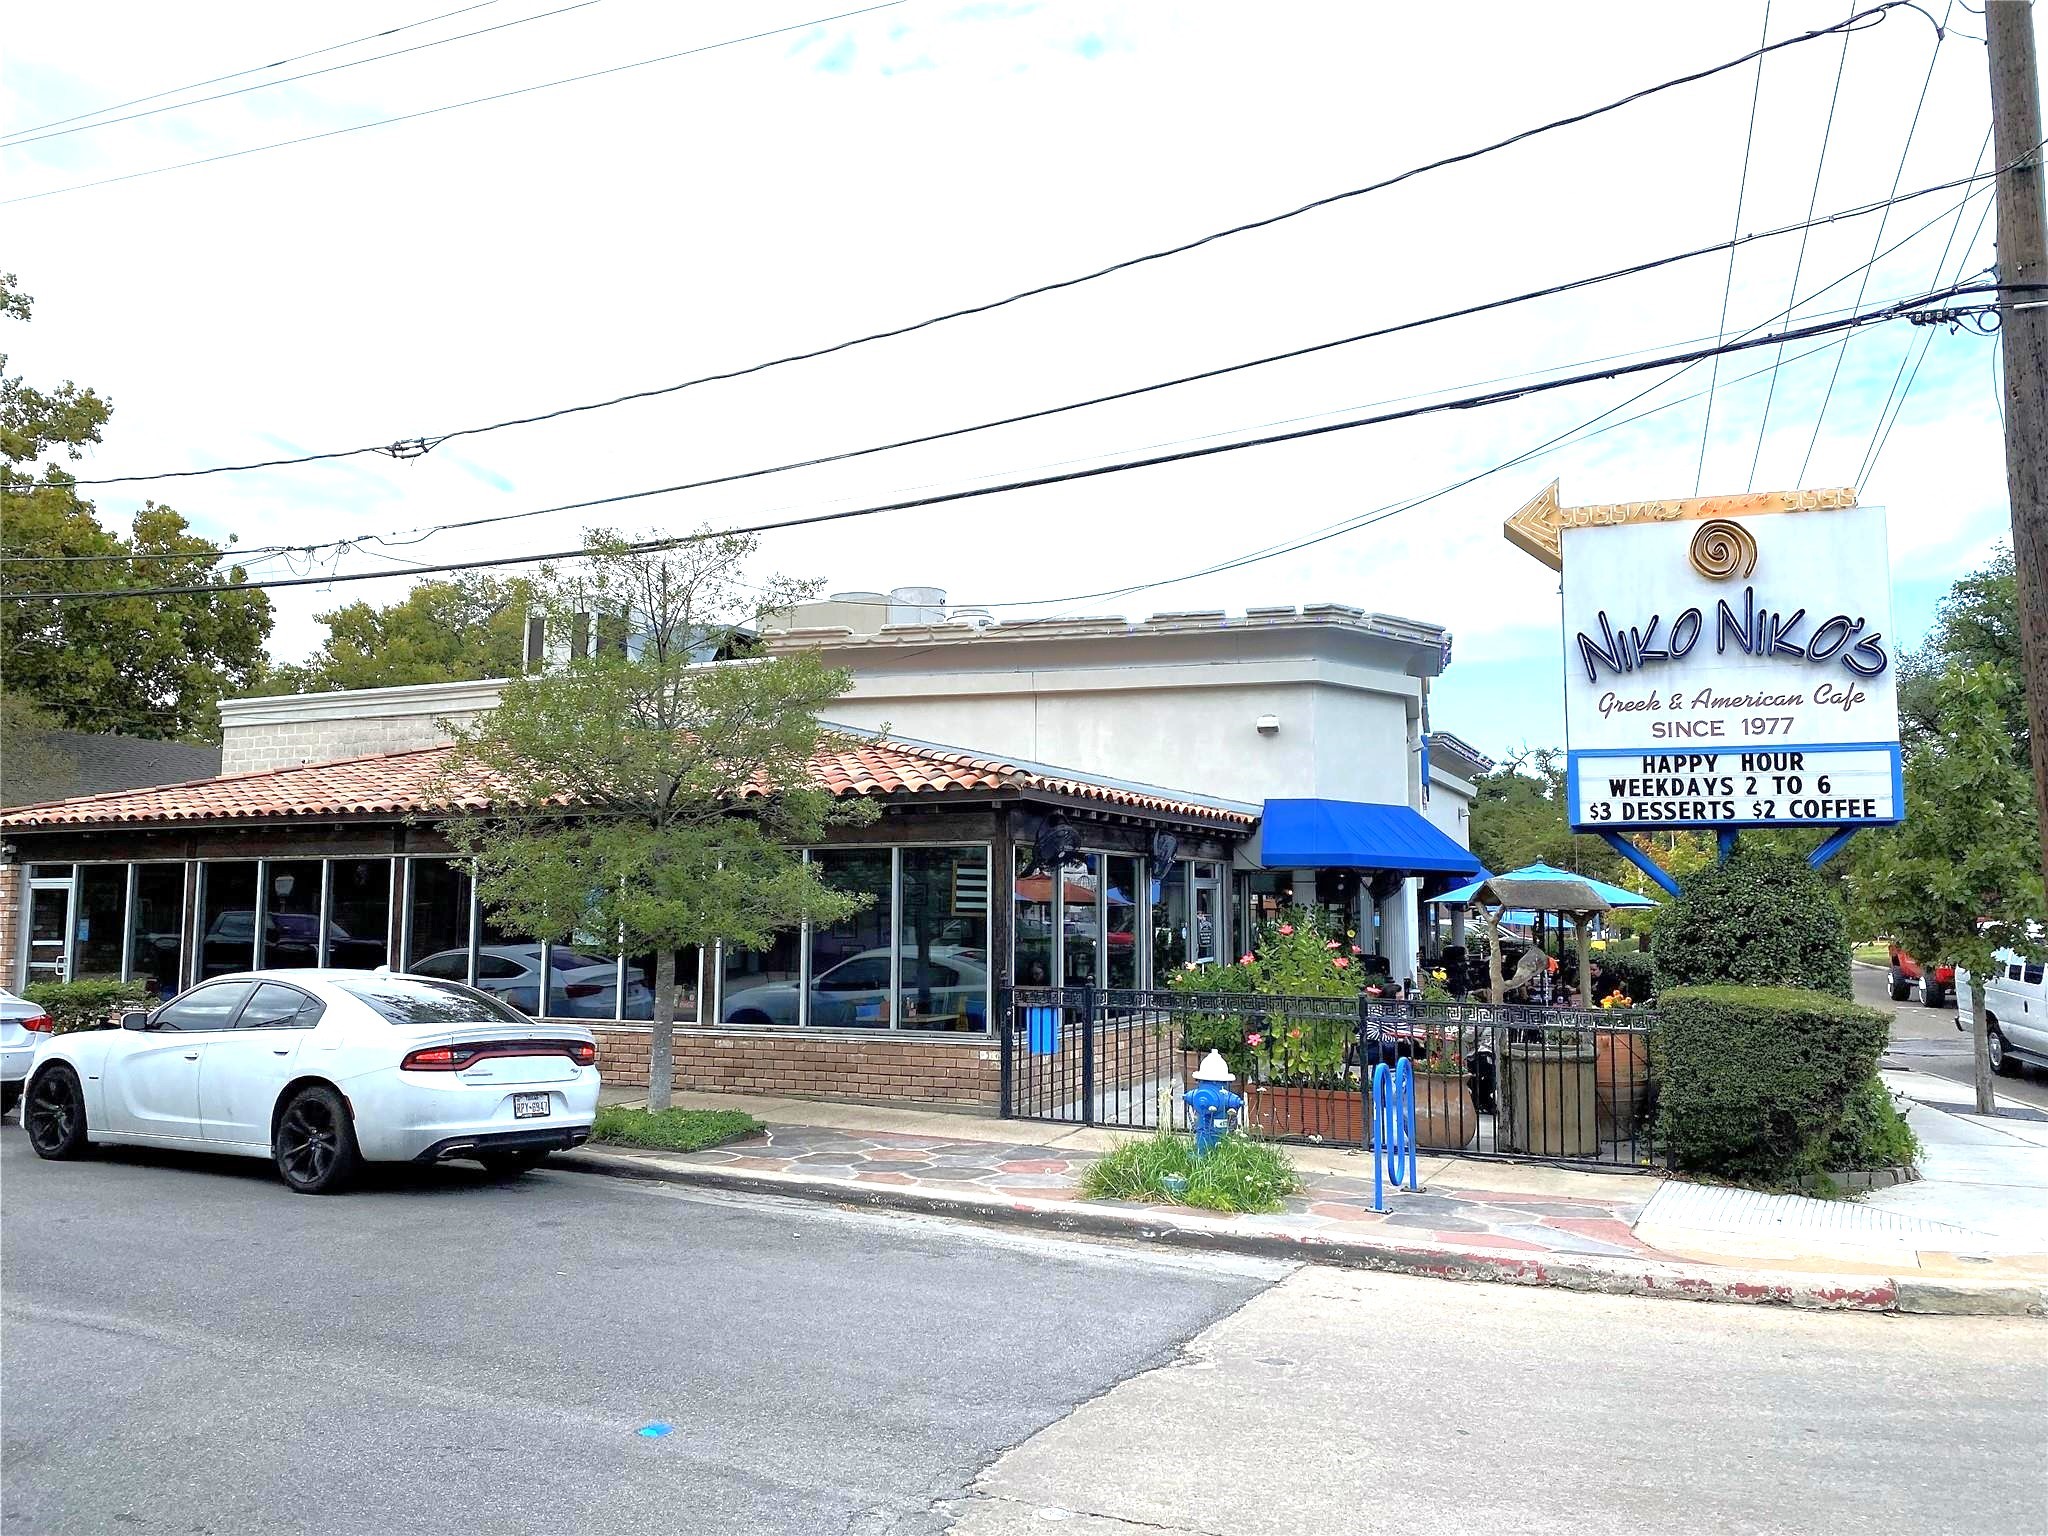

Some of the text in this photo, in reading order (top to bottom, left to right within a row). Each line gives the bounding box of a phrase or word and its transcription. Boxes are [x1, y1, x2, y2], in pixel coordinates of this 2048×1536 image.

[1577, 609, 1701, 683] NIKO
[1598, 682, 1867, 719] Greek & American Cafe
[1651, 716, 1795, 738] SINCE 1977
[1642, 751, 1804, 774] HAPPY HOUR
[1609, 775, 1831, 798] WEEKDAYS 2 TO 6
[1589, 798, 1877, 821] $3 DESSERTS $2 COFFEE
